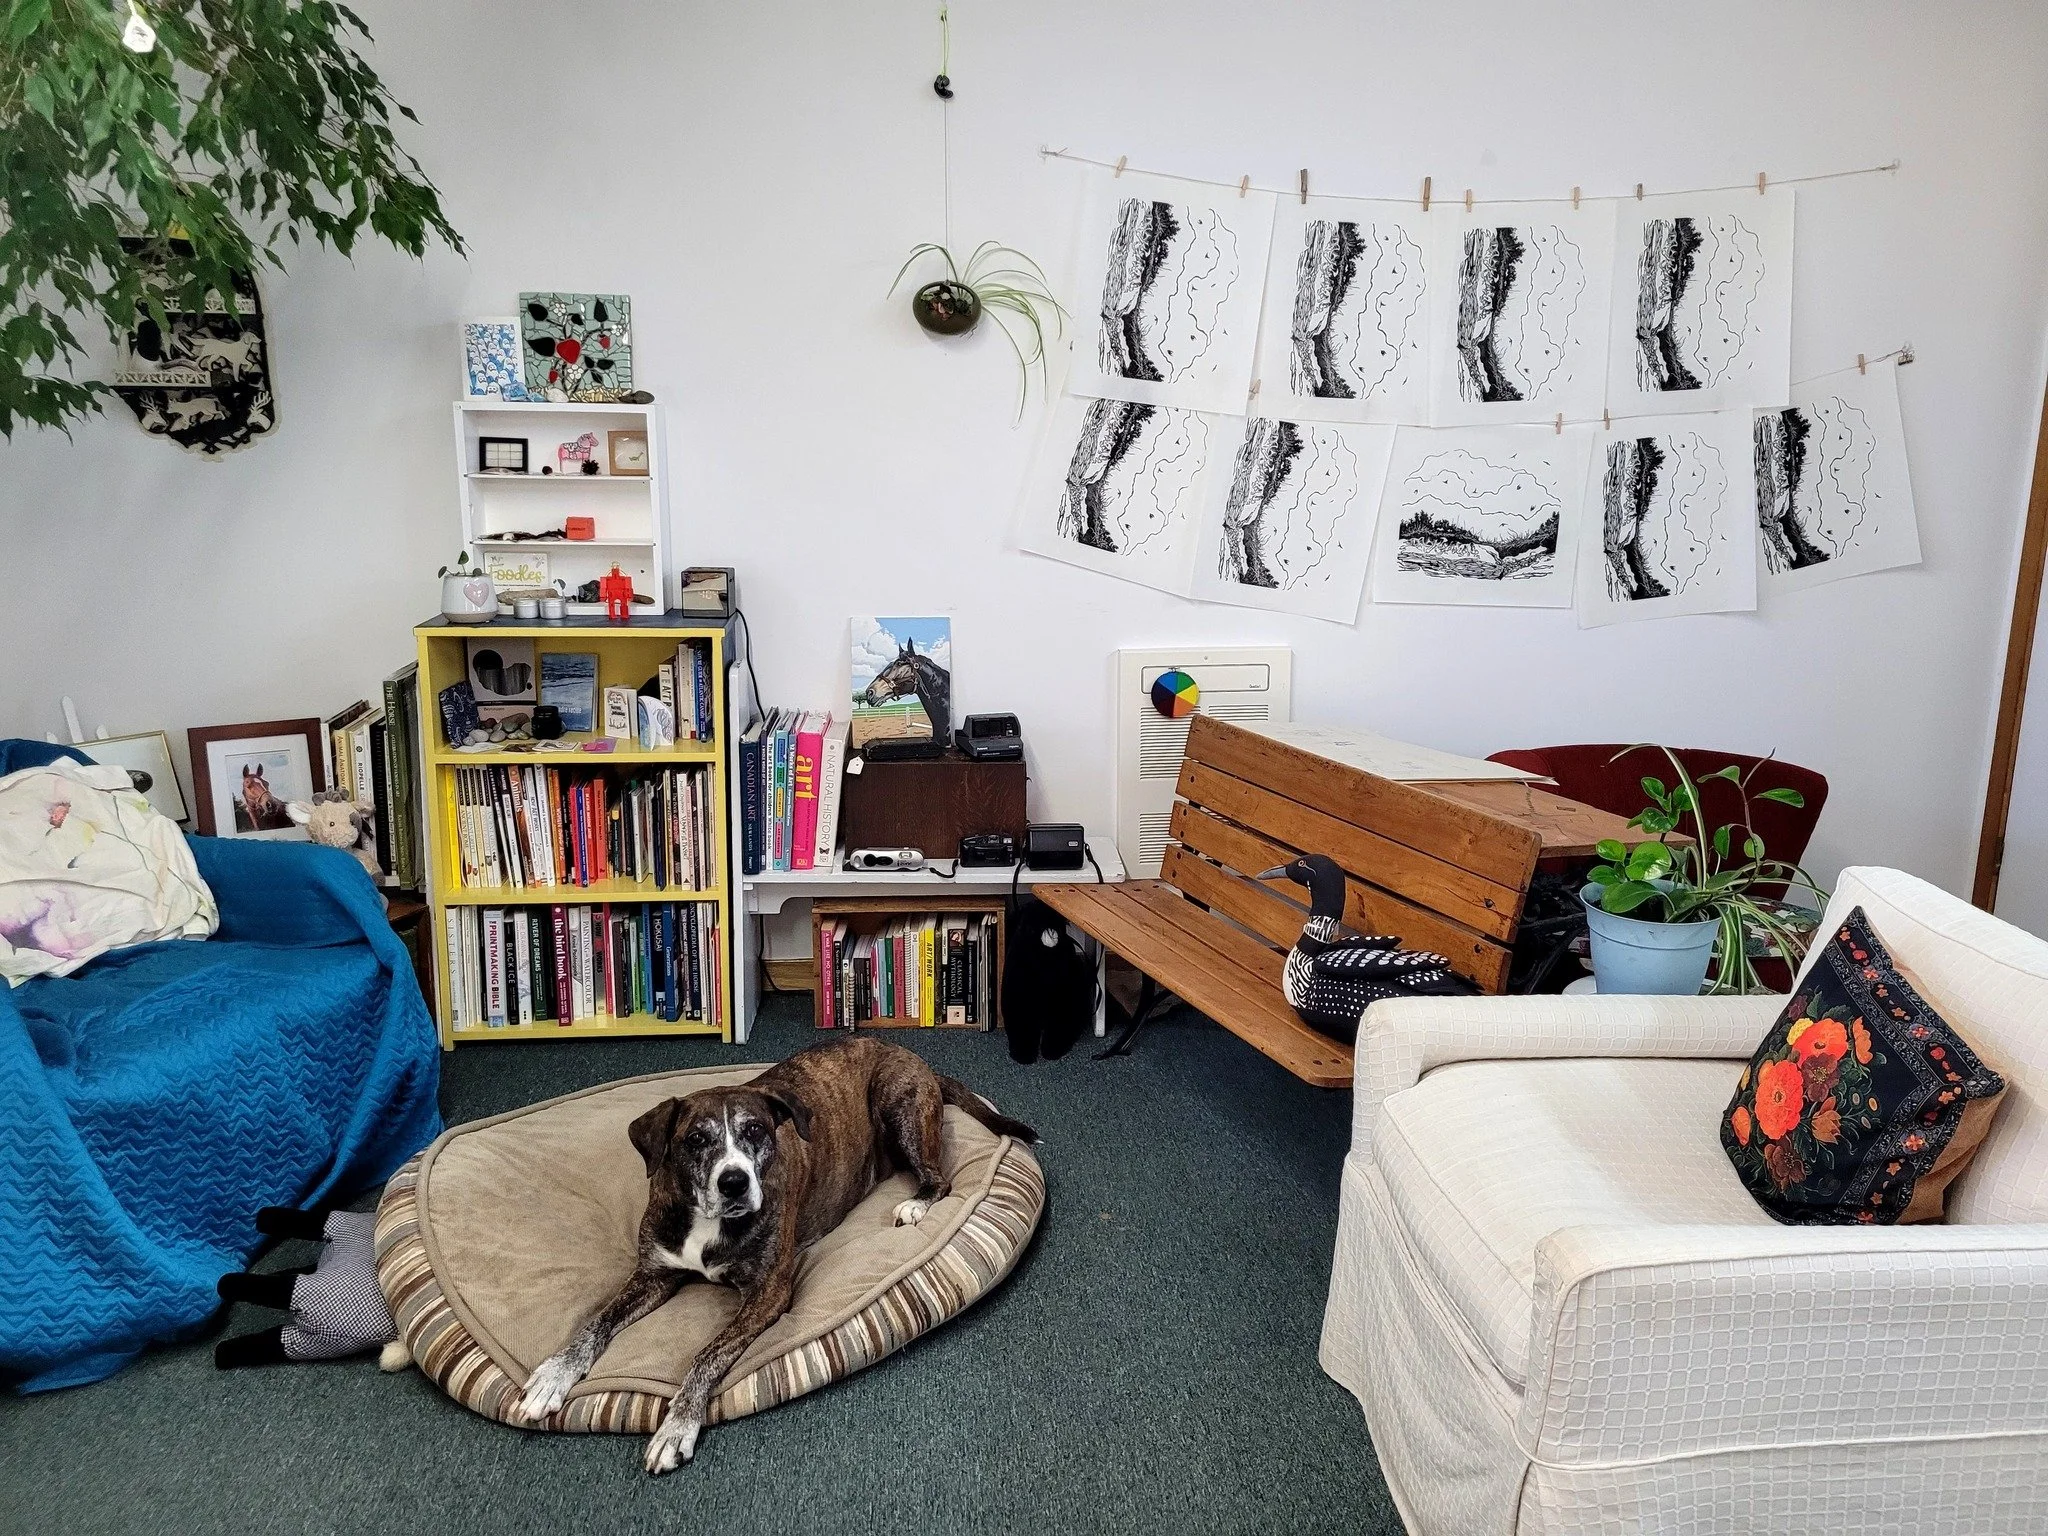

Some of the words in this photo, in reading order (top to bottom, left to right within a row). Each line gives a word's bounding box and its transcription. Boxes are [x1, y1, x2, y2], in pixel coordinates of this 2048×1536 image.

[386, 686, 394, 699] THE
[387, 701, 396, 726] HORSE
[337, 736, 345, 757] ANIMAL
[339, 759, 347, 785] ANATOMY
[357, 762, 365, 790] RIOPELLE
[746, 752, 755, 801] CANADIAN
[795, 755, 817, 801] art
[824, 754, 836, 801] NATURAL
[511, 780, 522, 812] Animals
[747, 804, 756, 821] ART
[821, 804, 833, 846] HISTORY
[554, 919, 563, 933] the
[583, 921, 591, 953] PAINTING
[689, 904, 697, 948] ENCYCLOPEDIA
[448, 919, 456, 974] SISTERS
[490, 925, 499, 985] PRINTMAKING
[506, 943, 514, 967] BLACK
[556, 935, 565, 954] bird
[692, 950, 698, 958] OF
[557, 956, 567, 980] book
[826, 961, 830, 969] NO
[584, 959, 592, 1004] WATERCOLOR
